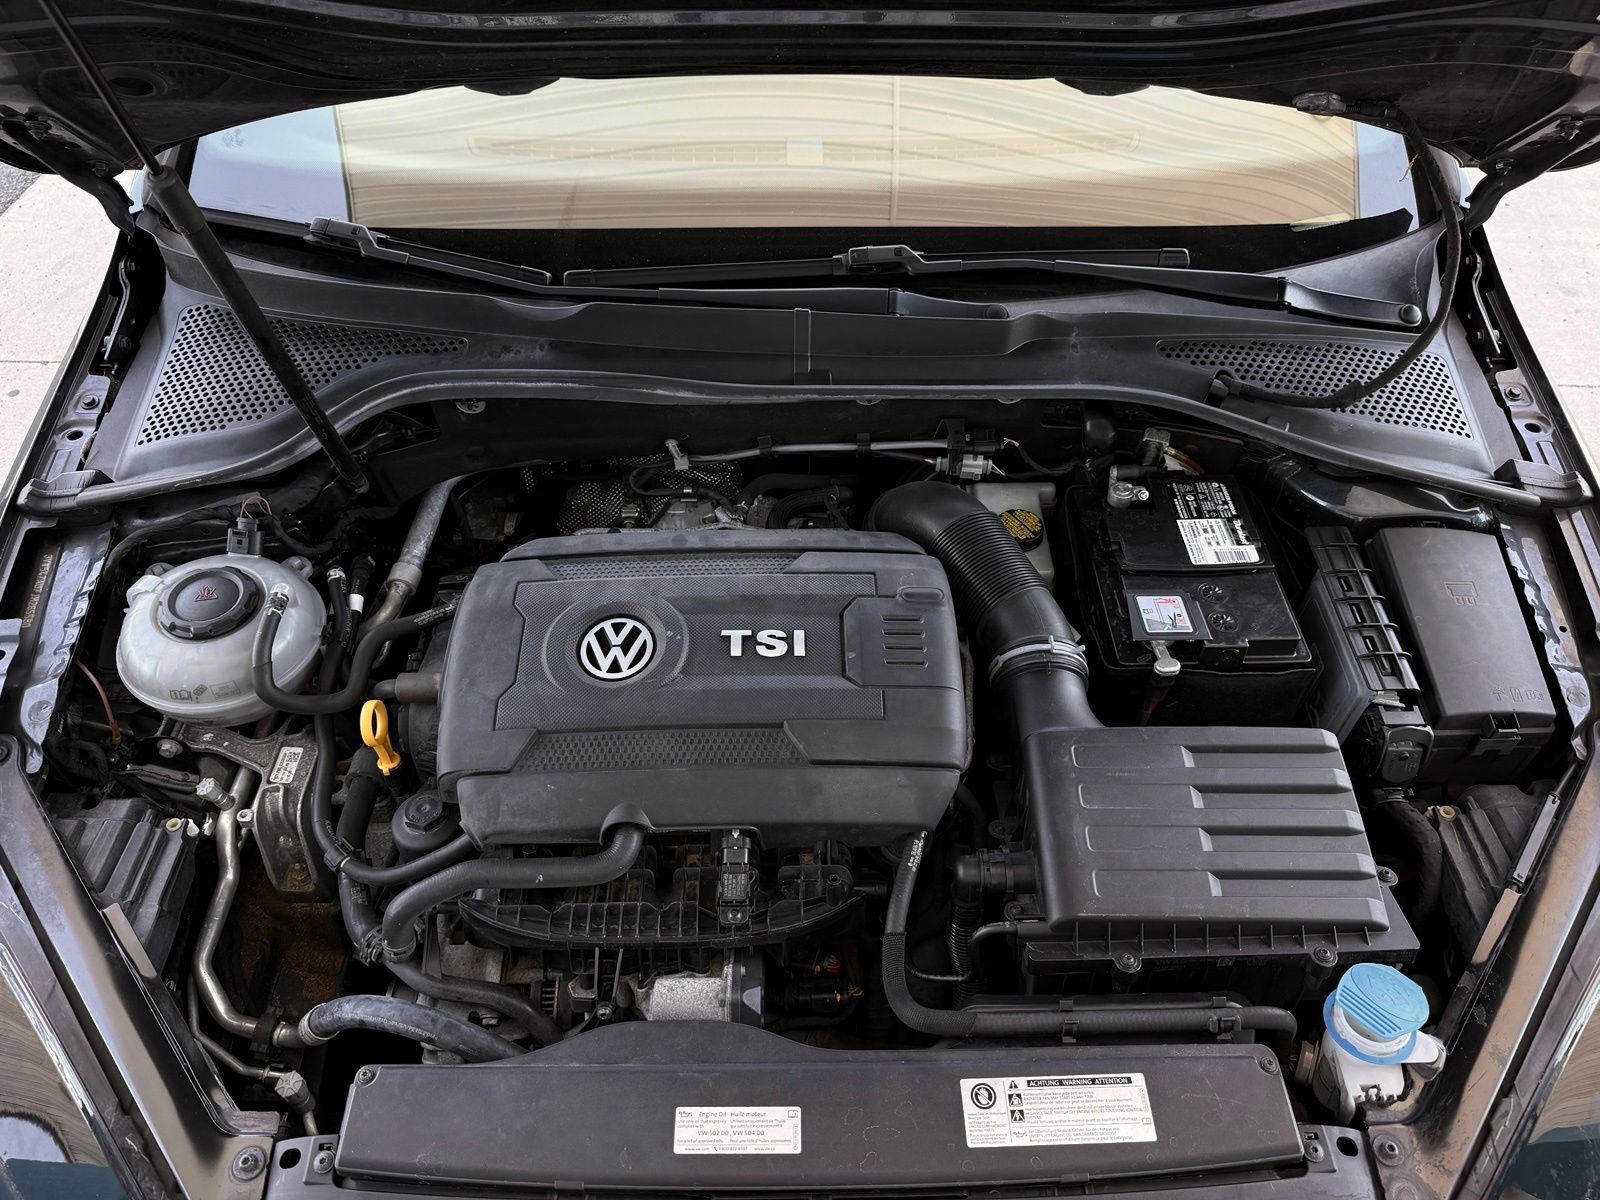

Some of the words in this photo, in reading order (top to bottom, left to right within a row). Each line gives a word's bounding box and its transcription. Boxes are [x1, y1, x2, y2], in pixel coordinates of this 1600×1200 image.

[1232, 520, 1250, 544] Duralast
[580, 617, 654, 680] VW
[721, 630, 806, 657] TSI
